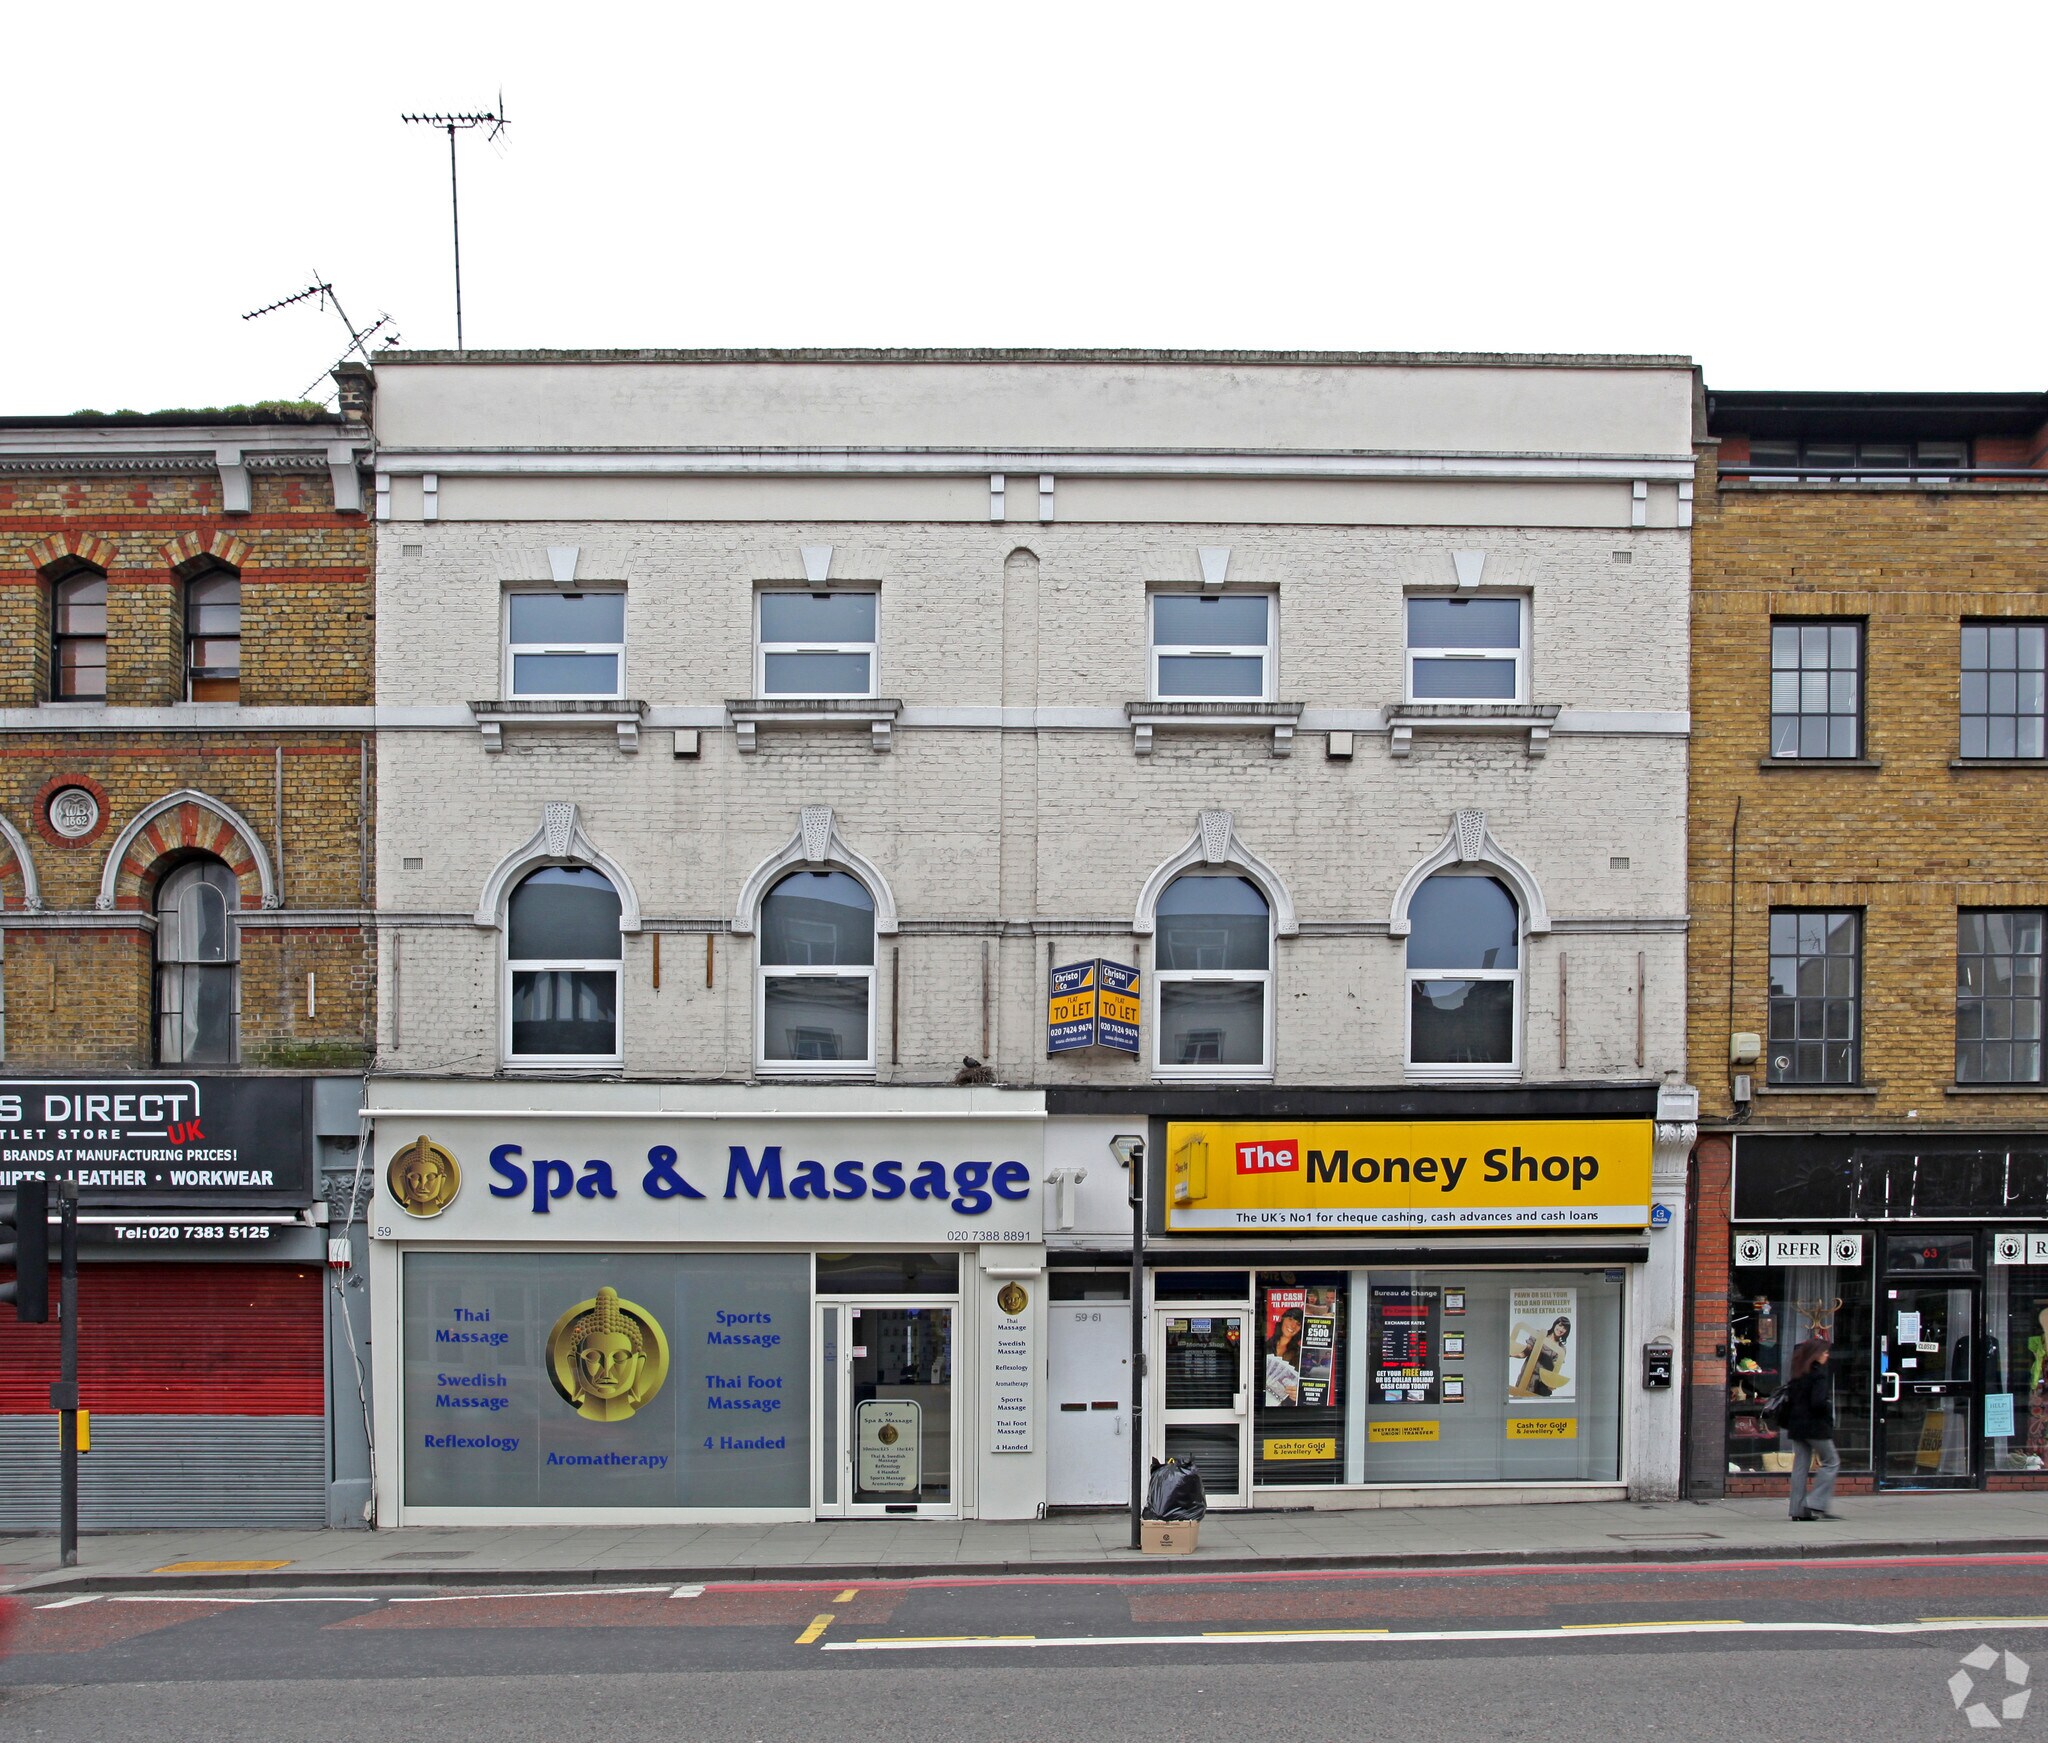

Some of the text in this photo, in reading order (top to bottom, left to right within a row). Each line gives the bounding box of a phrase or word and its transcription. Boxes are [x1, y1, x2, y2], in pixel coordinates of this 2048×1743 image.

[1055, 972, 1078, 983] Christo
[1104, 968, 1125, 980] Christo
[1054, 1002, 1091, 1020] TO LET
[1103, 1002, 1136, 1021] TO LET
[1050, 1022, 1092, 1037] 020 7424 9474
[1101, 1022, 1138, 1038] 020 7424 9474
[45, 1095, 188, 1122] DIRECT
[57, 1129, 121, 1140] STORE
[167, 1119, 206, 1145] UK
[3, 1149, 238, 1161] BRANDS AT MANUFACTURING PRICES!
[1240, 1145, 1599, 1192] The Money Shop
[170, 1171, 274, 1186] WORKWEAR
[488, 1144, 1030, 1214] Spa & Massage
[1236, 1213, 1257, 1223] The
[1290, 1212, 1312, 1223] No1
[1316, 1212, 1333, 1223] for
[1336, 1213, 1378, 1224] cheque
[1381, 1212, 1427, 1224] cashing,
[1431, 1211, 1456, 1222] cash
[1460, 1211, 1512, 1222] advances
[1516, 1210, 1537, 1221] and
[1541, 1210, 1566, 1221] cash
[1569, 1210, 1599, 1220] loans
[184, 1227, 224, 1239] 7383
[229, 1227, 270, 1239] 5125
[377, 1226, 391, 1236] 59
[947, 1231, 1031, 1241] 020 7388 8891
[1777, 1242, 1821, 1256] RFFR
[1923, 1248, 1938, 1258] 63
[1271, 1293, 1303, 1301] NO CASH
[454, 1308, 490, 1322] Thai
[716, 1310, 771, 1327] Sports
[1075, 1313, 1102, 1322] 59 61
[435, 1330, 509, 1346] Massage
[1308, 1328, 1328, 1337] £500
[707, 1332, 781, 1348] Massage
[1918, 1343, 1936, 1351] CLOSED
[437, 1373, 507, 1387] Swedish
[706, 1375, 782, 1389] Thai Foot
[435, 1394, 509, 1411] Massage
[707, 1396, 781, 1413] Massage
[424, 1434, 520, 1451] Reflexology
[703, 1436, 786, 1449] 4 Handed
[546, 1452, 668, 1469] Aromatherapy
